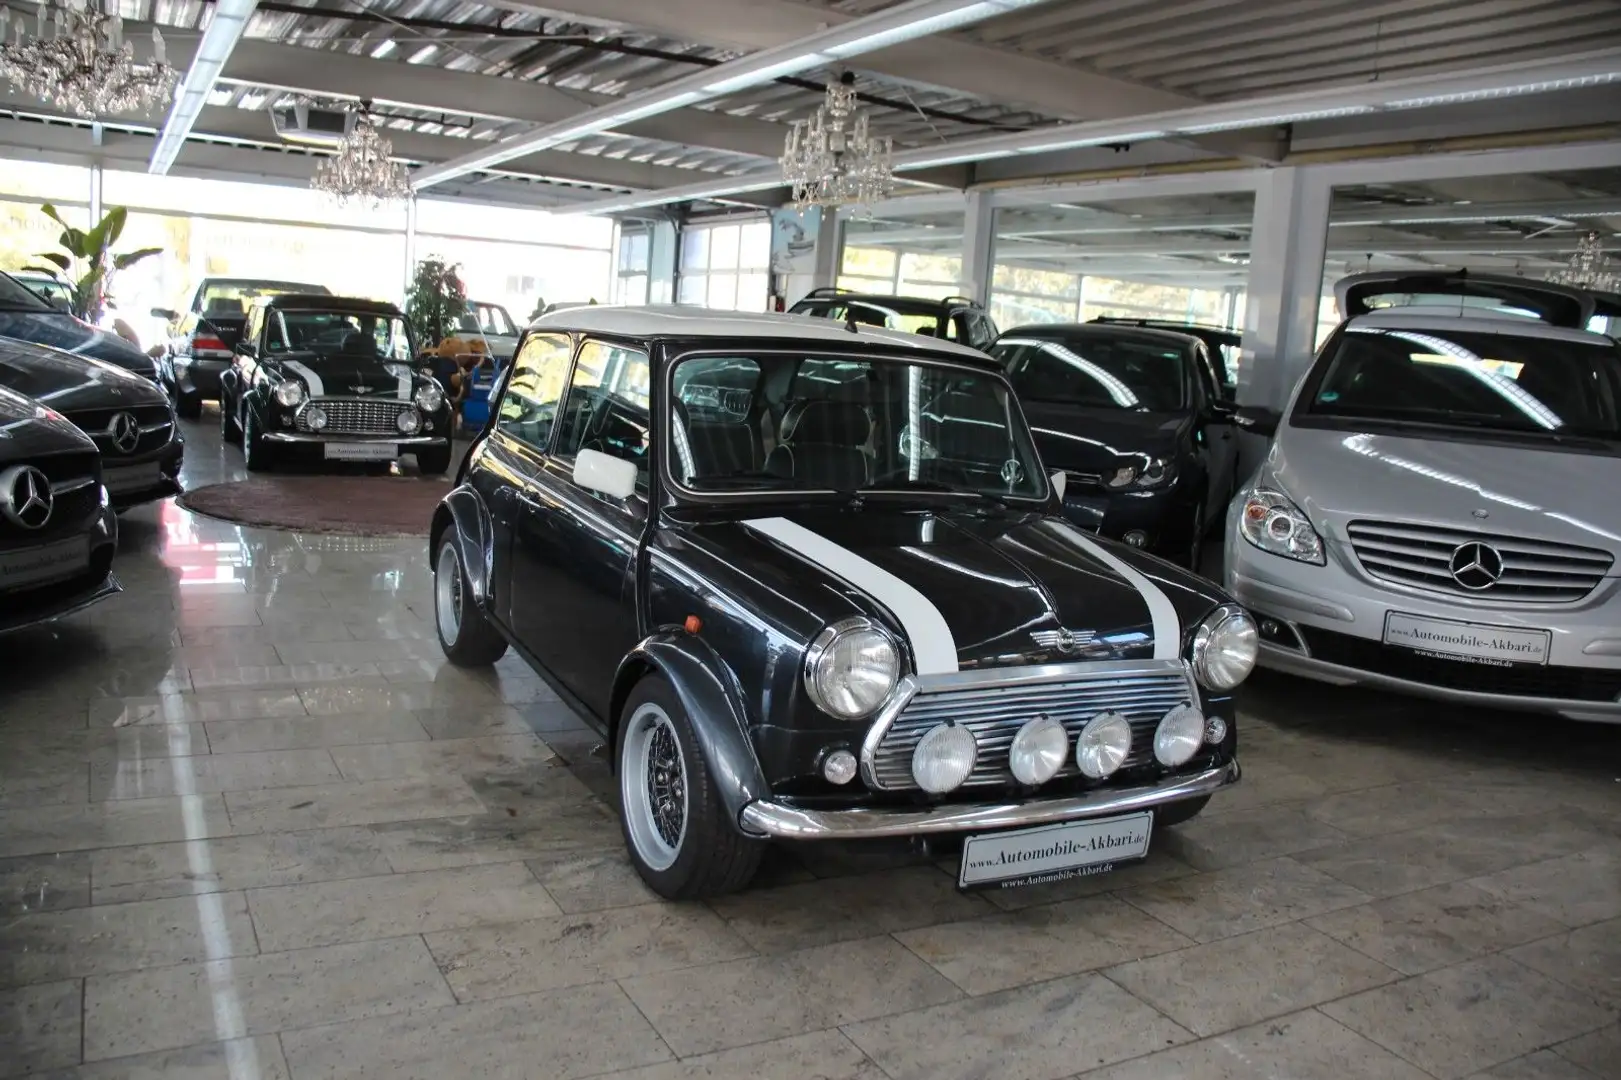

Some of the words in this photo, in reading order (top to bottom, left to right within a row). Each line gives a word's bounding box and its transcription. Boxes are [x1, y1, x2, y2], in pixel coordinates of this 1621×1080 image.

[1391, 628, 1542, 653] www.Automobile-Akbari.de
[969, 831, 1144, 869] www.Automobile-Akbari.de
[1001, 863, 1113, 888] www.Automobile-Akbari.de
